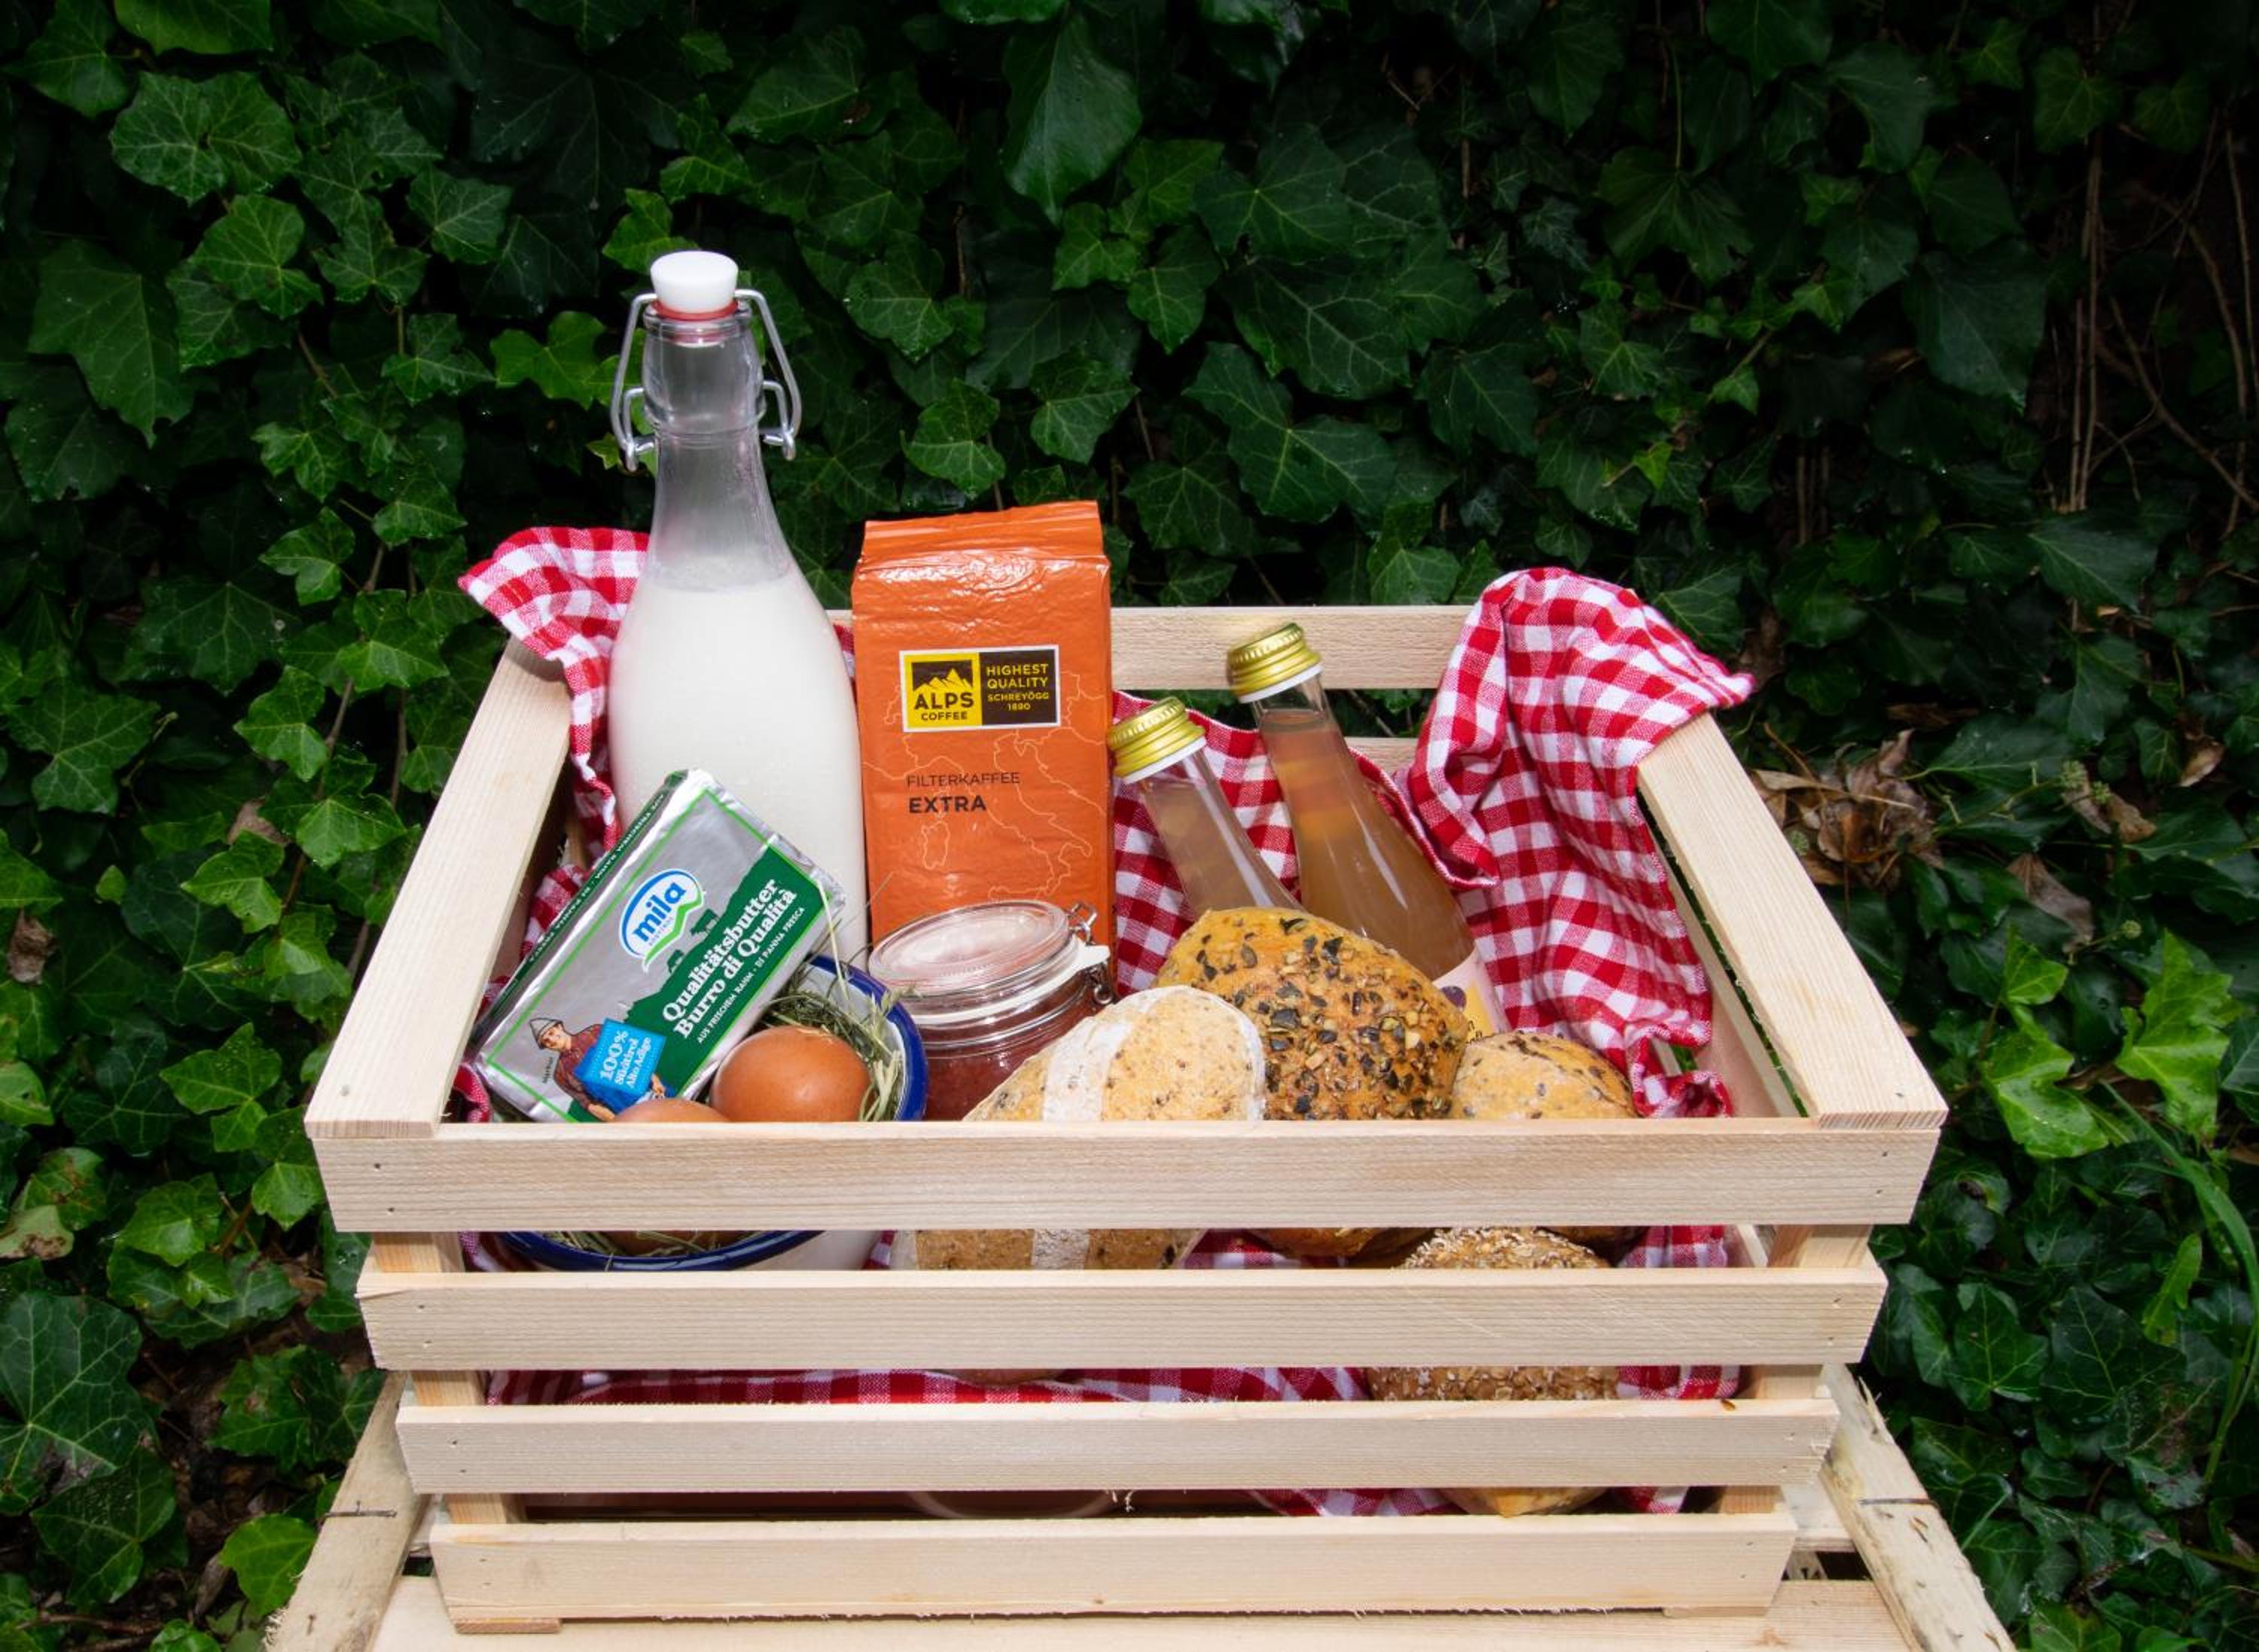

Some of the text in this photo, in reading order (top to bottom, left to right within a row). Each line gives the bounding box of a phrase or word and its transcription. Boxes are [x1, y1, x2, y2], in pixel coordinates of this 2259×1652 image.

[986, 663, 1049, 677] HIGHEST
[987, 677, 1049, 690] QUALITY
[914, 692, 974, 710] ALPS
[987, 690, 1049, 702] SCHREYÖGG
[921, 712, 968, 721] COFFEE
[907, 772, 1020, 787] FILTERKAFFEE
[909, 794, 986, 813] EXTRA
[633, 882, 687, 942] mila
[662, 879, 778, 1021] Qualitätsbutter
[673, 888, 797, 1039] Burro di Qualità
[697, 1027, 710, 1044] AUS
[708, 994, 737, 1029] FRISCHEM
[734, 971, 754, 995] RAHM
[762, 933, 785, 959] PANNA
[782, 907, 805, 932] FRESCA
[599, 1029, 629, 1081] 100%
